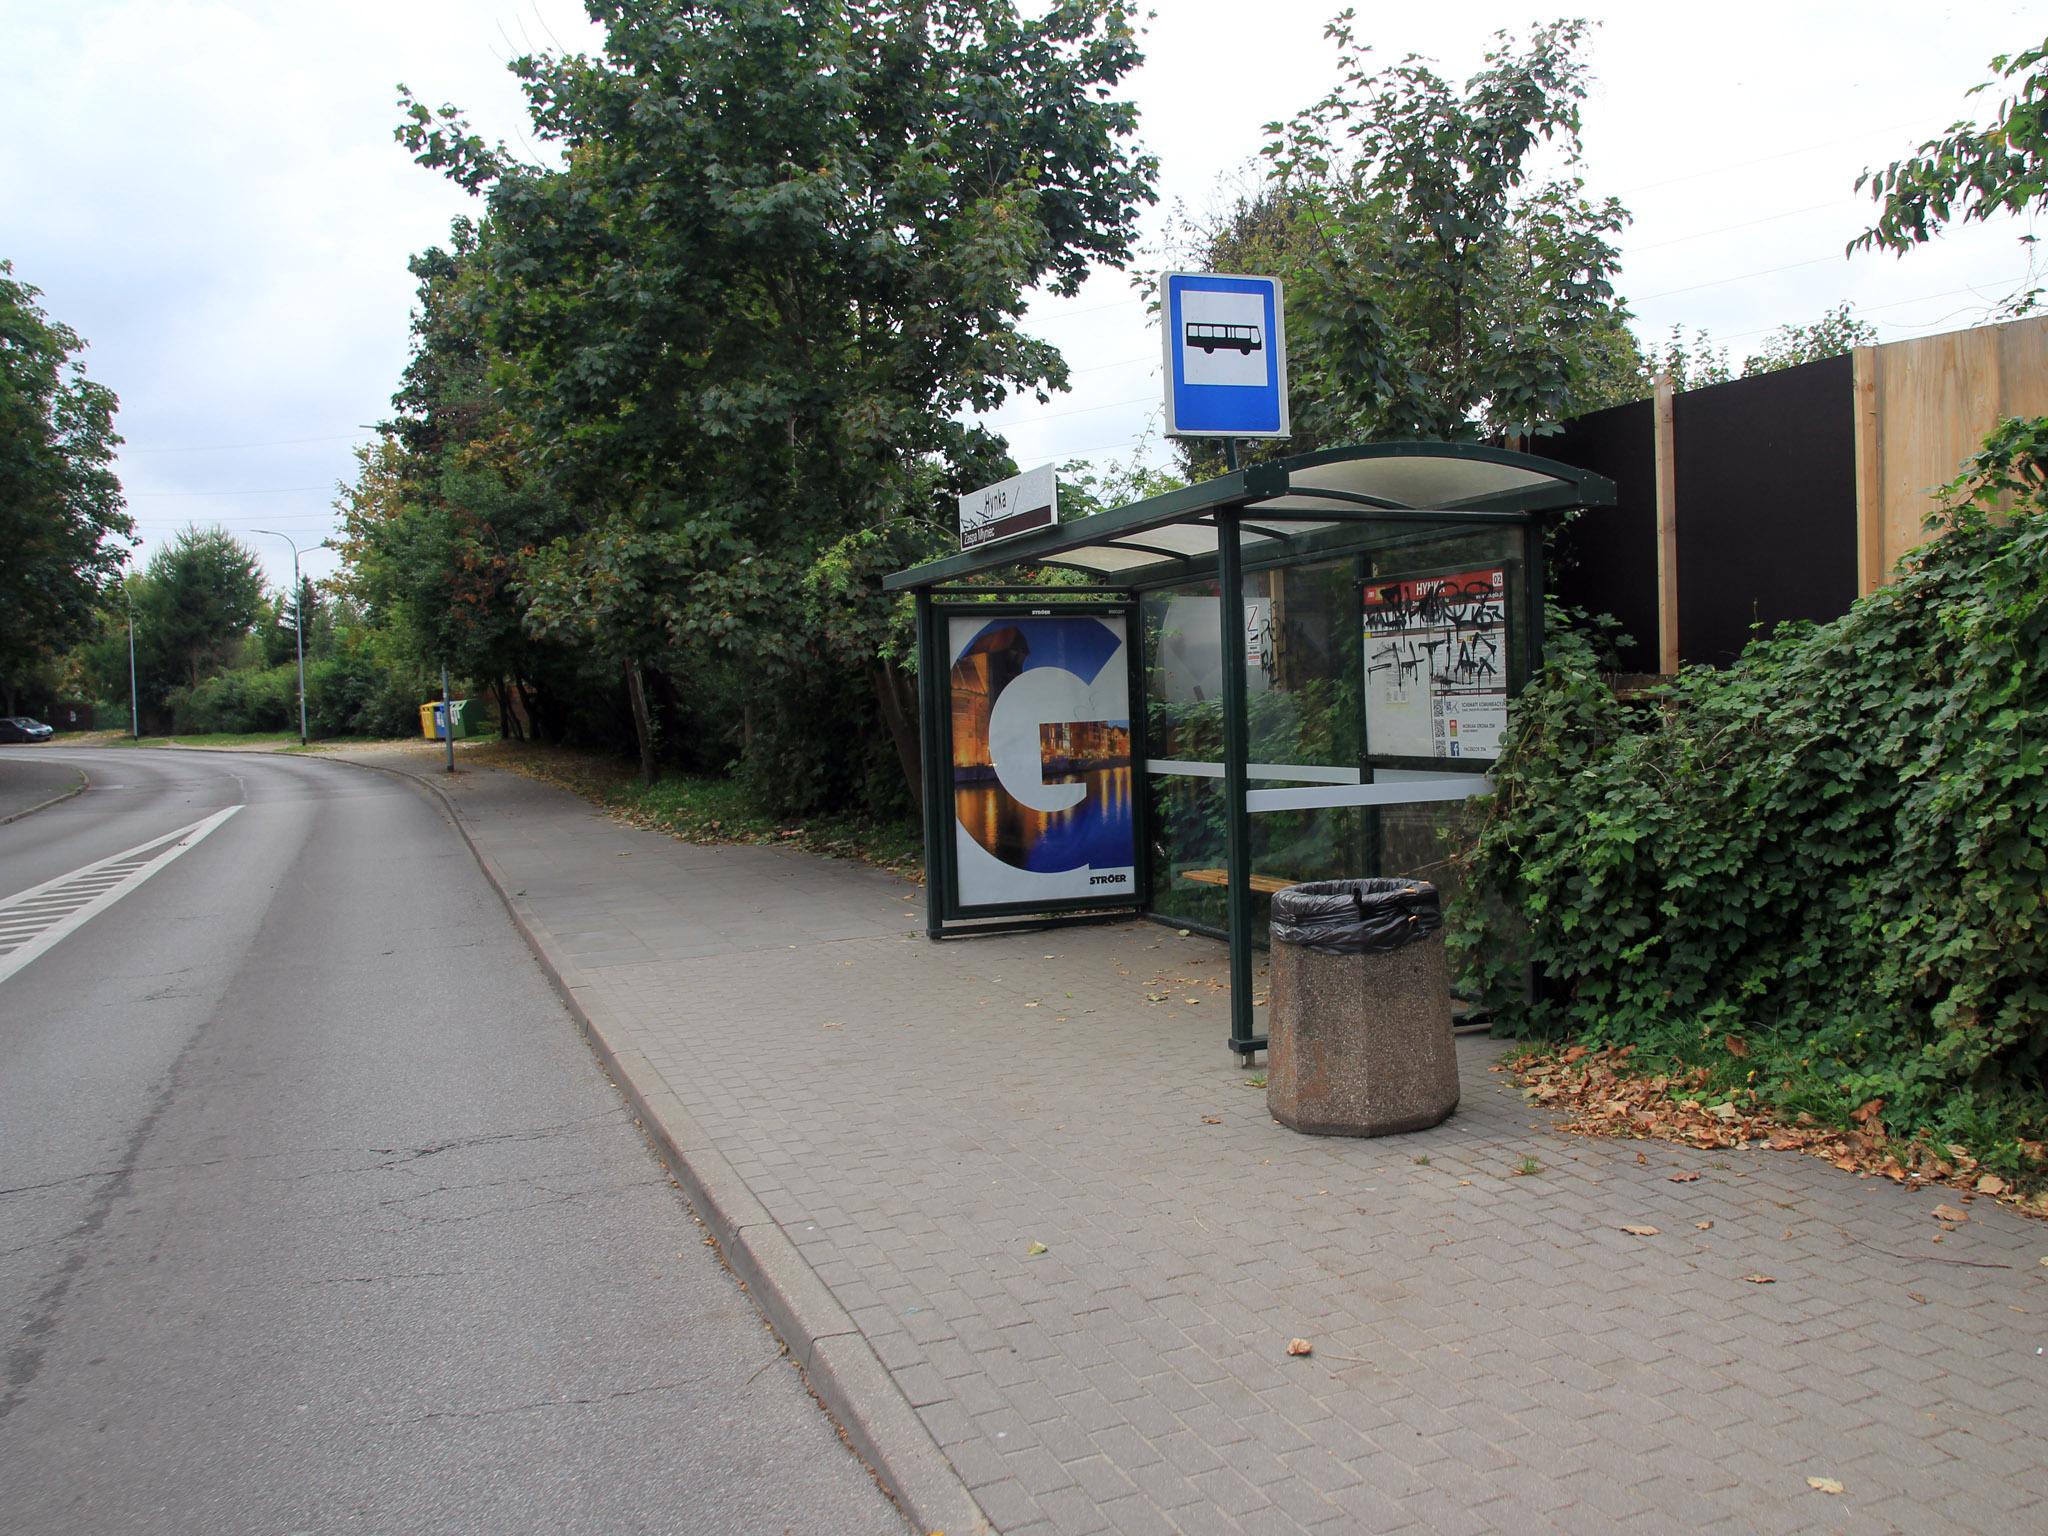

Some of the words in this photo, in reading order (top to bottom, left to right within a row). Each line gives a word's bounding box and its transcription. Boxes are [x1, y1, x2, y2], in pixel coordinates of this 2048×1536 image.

[985, 488, 1006, 517] Hynka
[1493, 574, 1502, 585] 02
[1089, 874, 1127, 885] STRÖER
